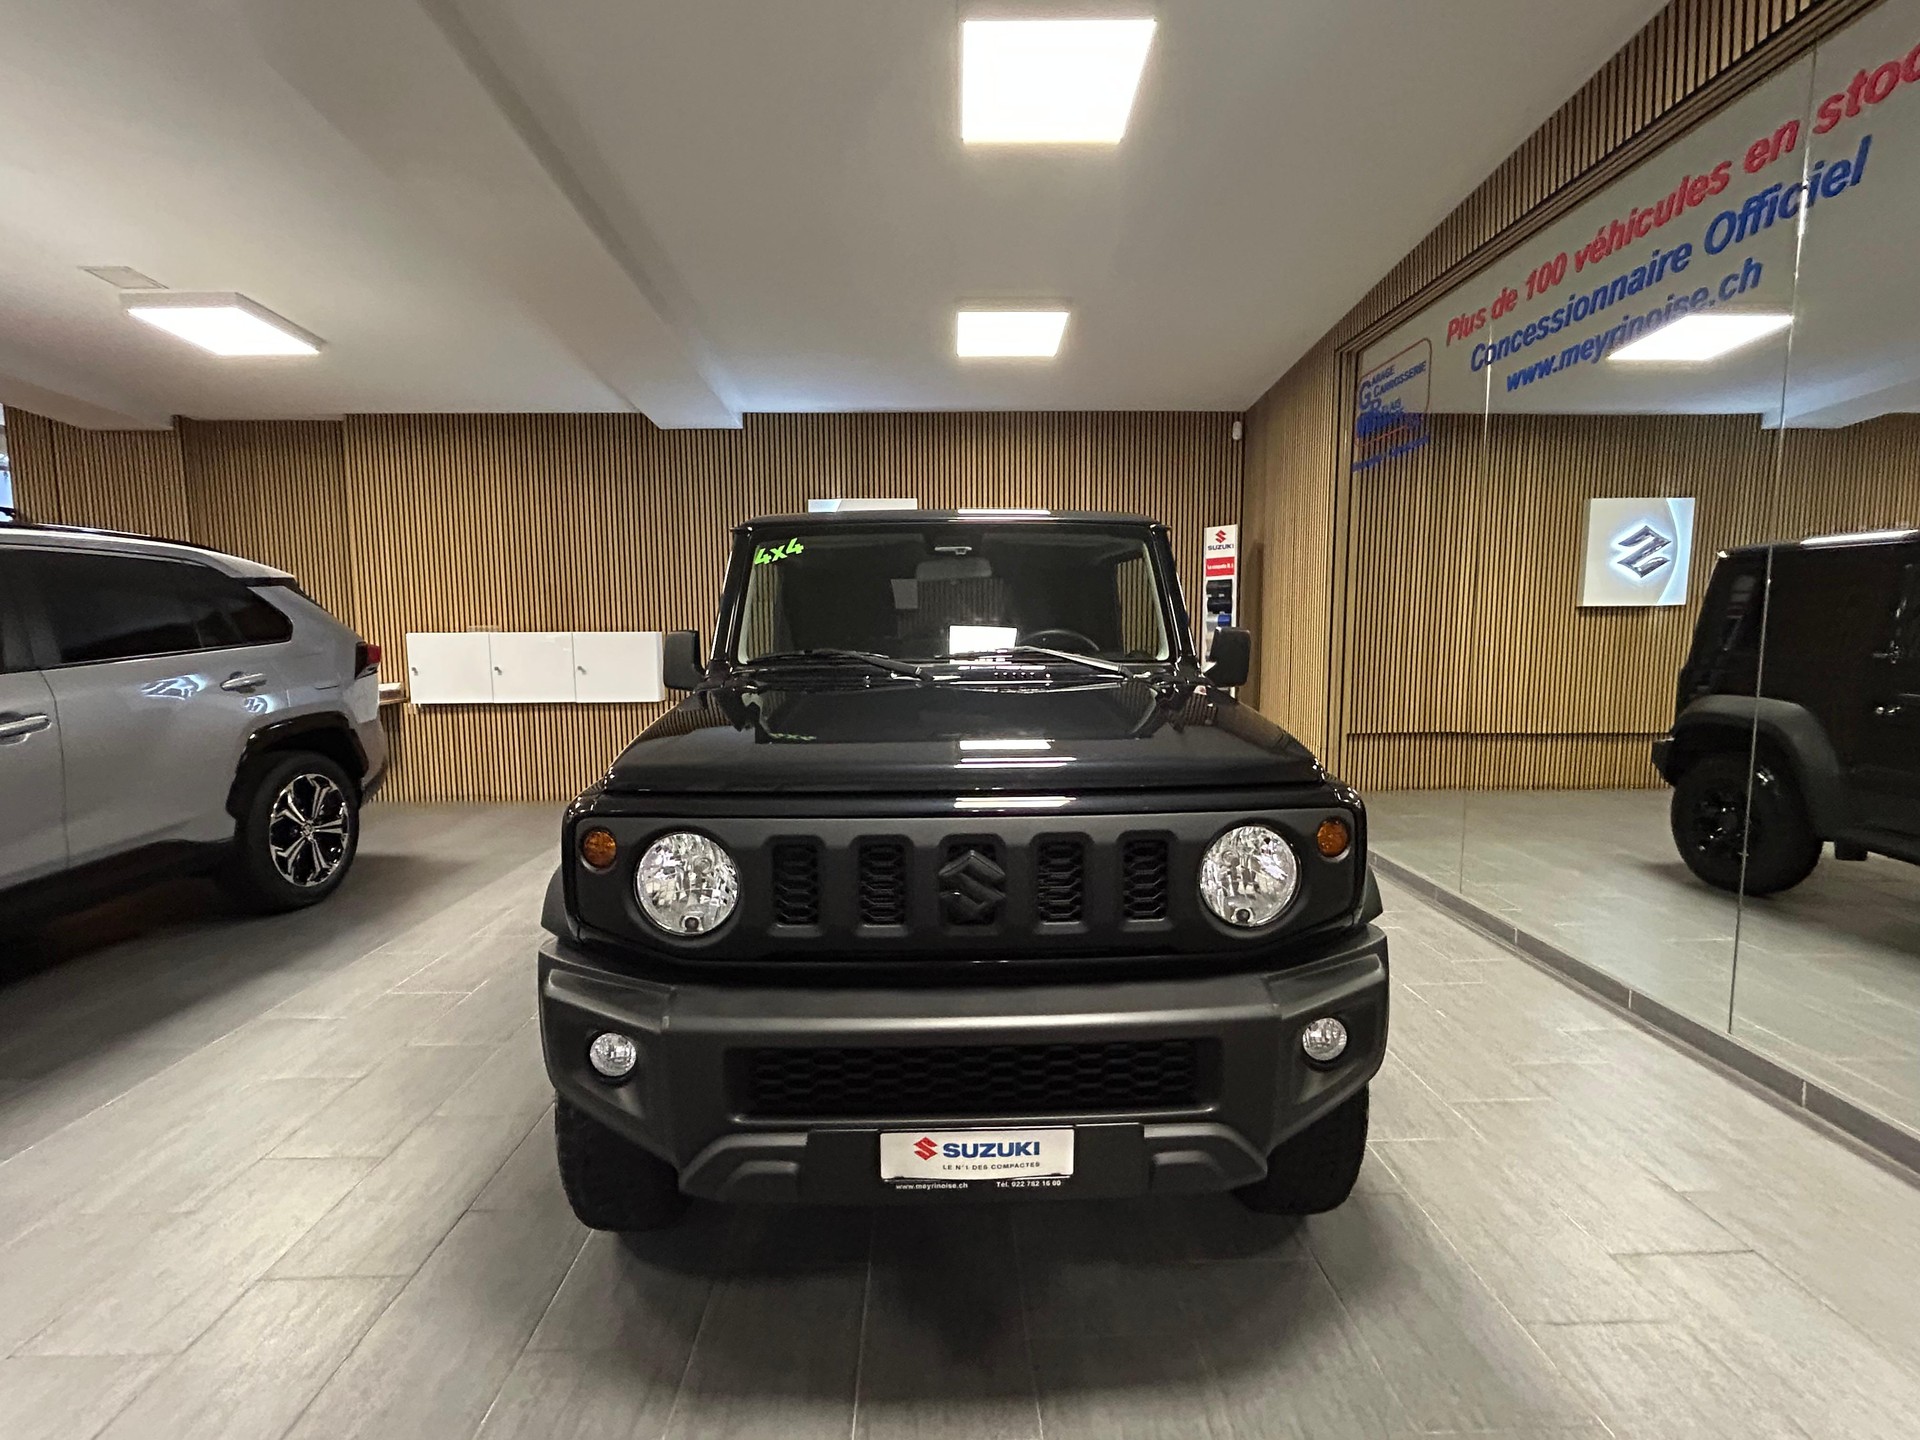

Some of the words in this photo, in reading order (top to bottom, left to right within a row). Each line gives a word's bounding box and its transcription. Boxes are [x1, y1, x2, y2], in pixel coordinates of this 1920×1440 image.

[1446, 310, 1486, 346] Plus
[1491, 287, 1518, 321] de
[1525, 253, 1568, 299] 100
[1575, 160, 1733, 273] véhicules
[1743, 119, 1800, 173] en
[1470, 242, 1692, 373] Concessionnaire
[1704, 134, 1873, 256] Officiel
[1506, 257, 1764, 392] www.meyrinoise.ch
[754, 537, 804, 565] 4x4
[942, 1141, 1040, 1158] SUZUKI
[942, 1163, 953, 1171] LE
[972, 1163, 989, 1171] DES
[990, 1161, 1041, 1170] COMPACTES
[895, 1182, 969, 1191] www.meyrinoise.ch
[1011, 1180, 1026, 1188] 022
